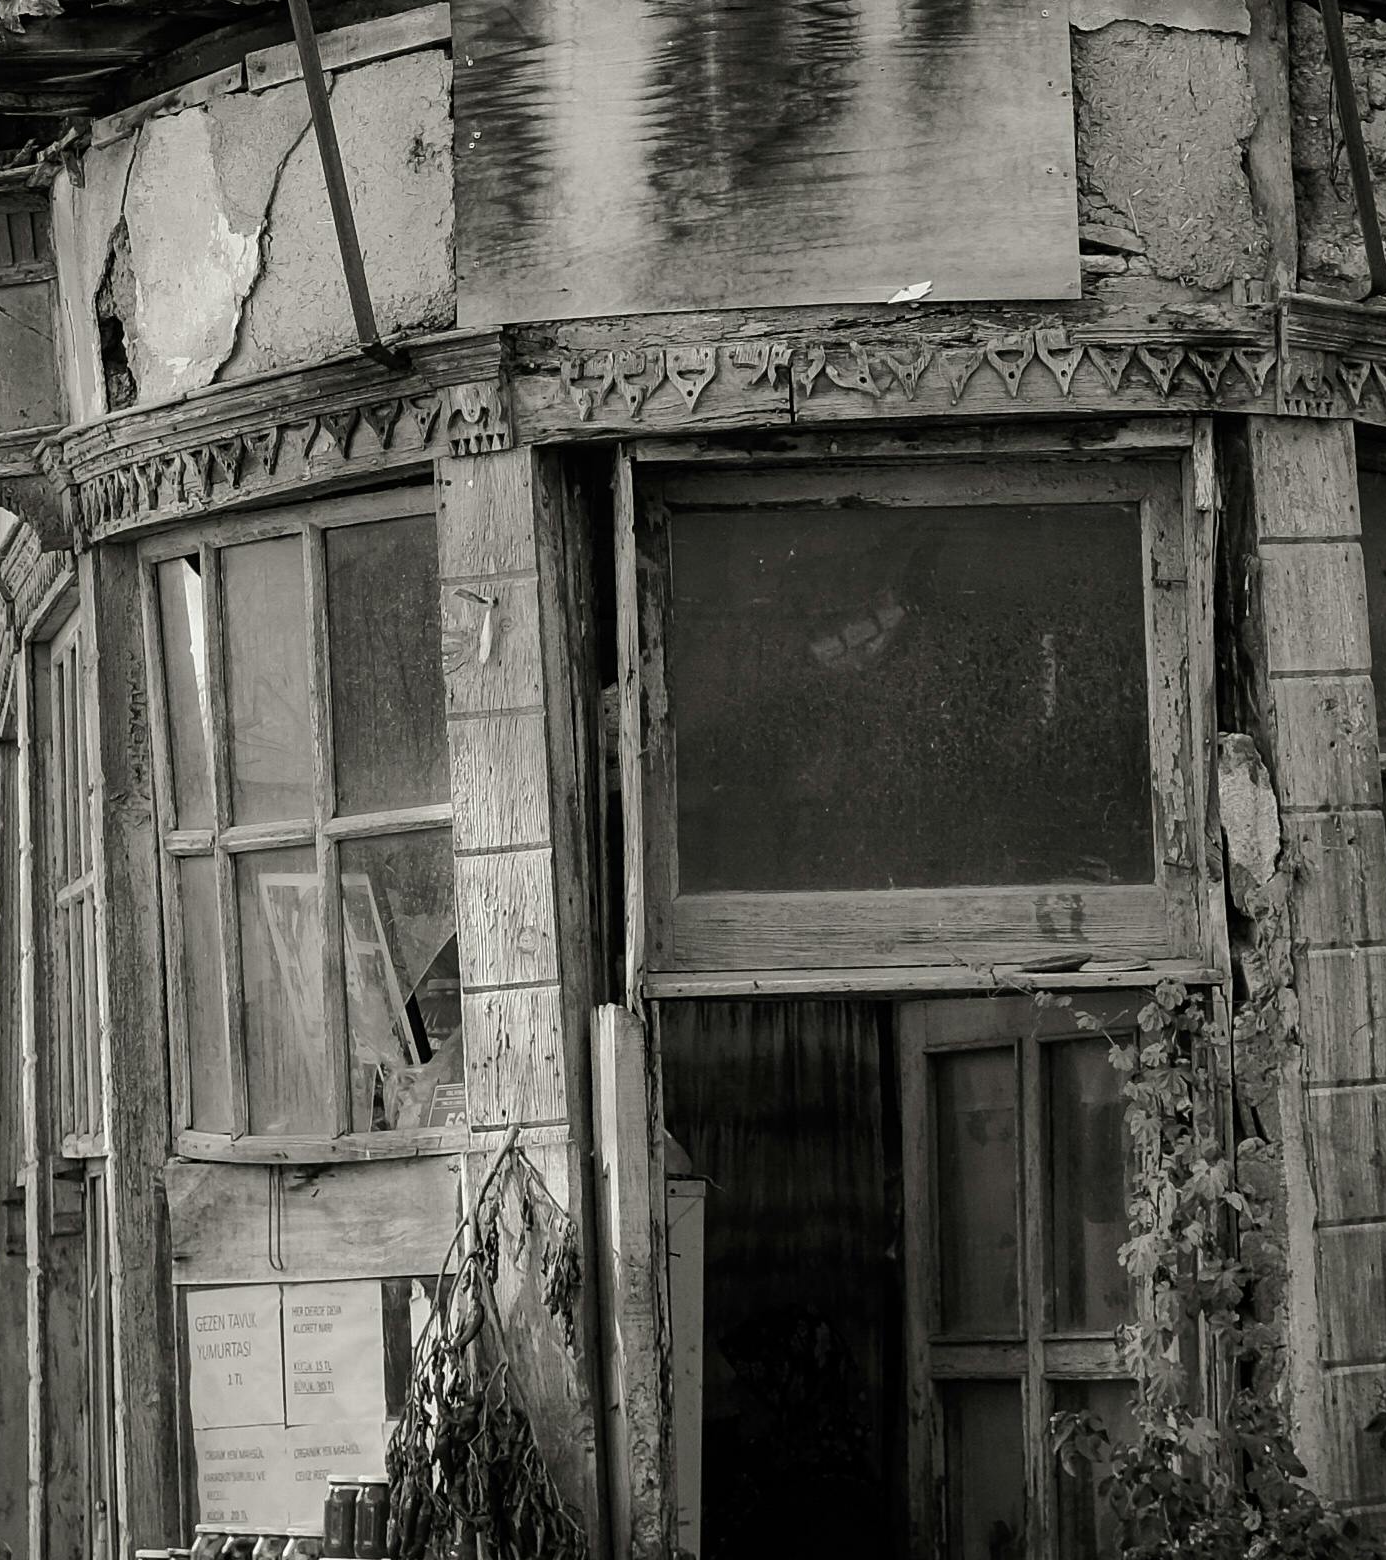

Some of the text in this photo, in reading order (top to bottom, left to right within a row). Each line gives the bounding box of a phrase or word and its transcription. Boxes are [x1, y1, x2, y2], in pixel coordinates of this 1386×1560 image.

[195, 1312, 258, 1333] GEZEN TAVUK
[196, 1340, 252, 1361] YUMURTASI
[234, 1373, 244, 1386] TL
